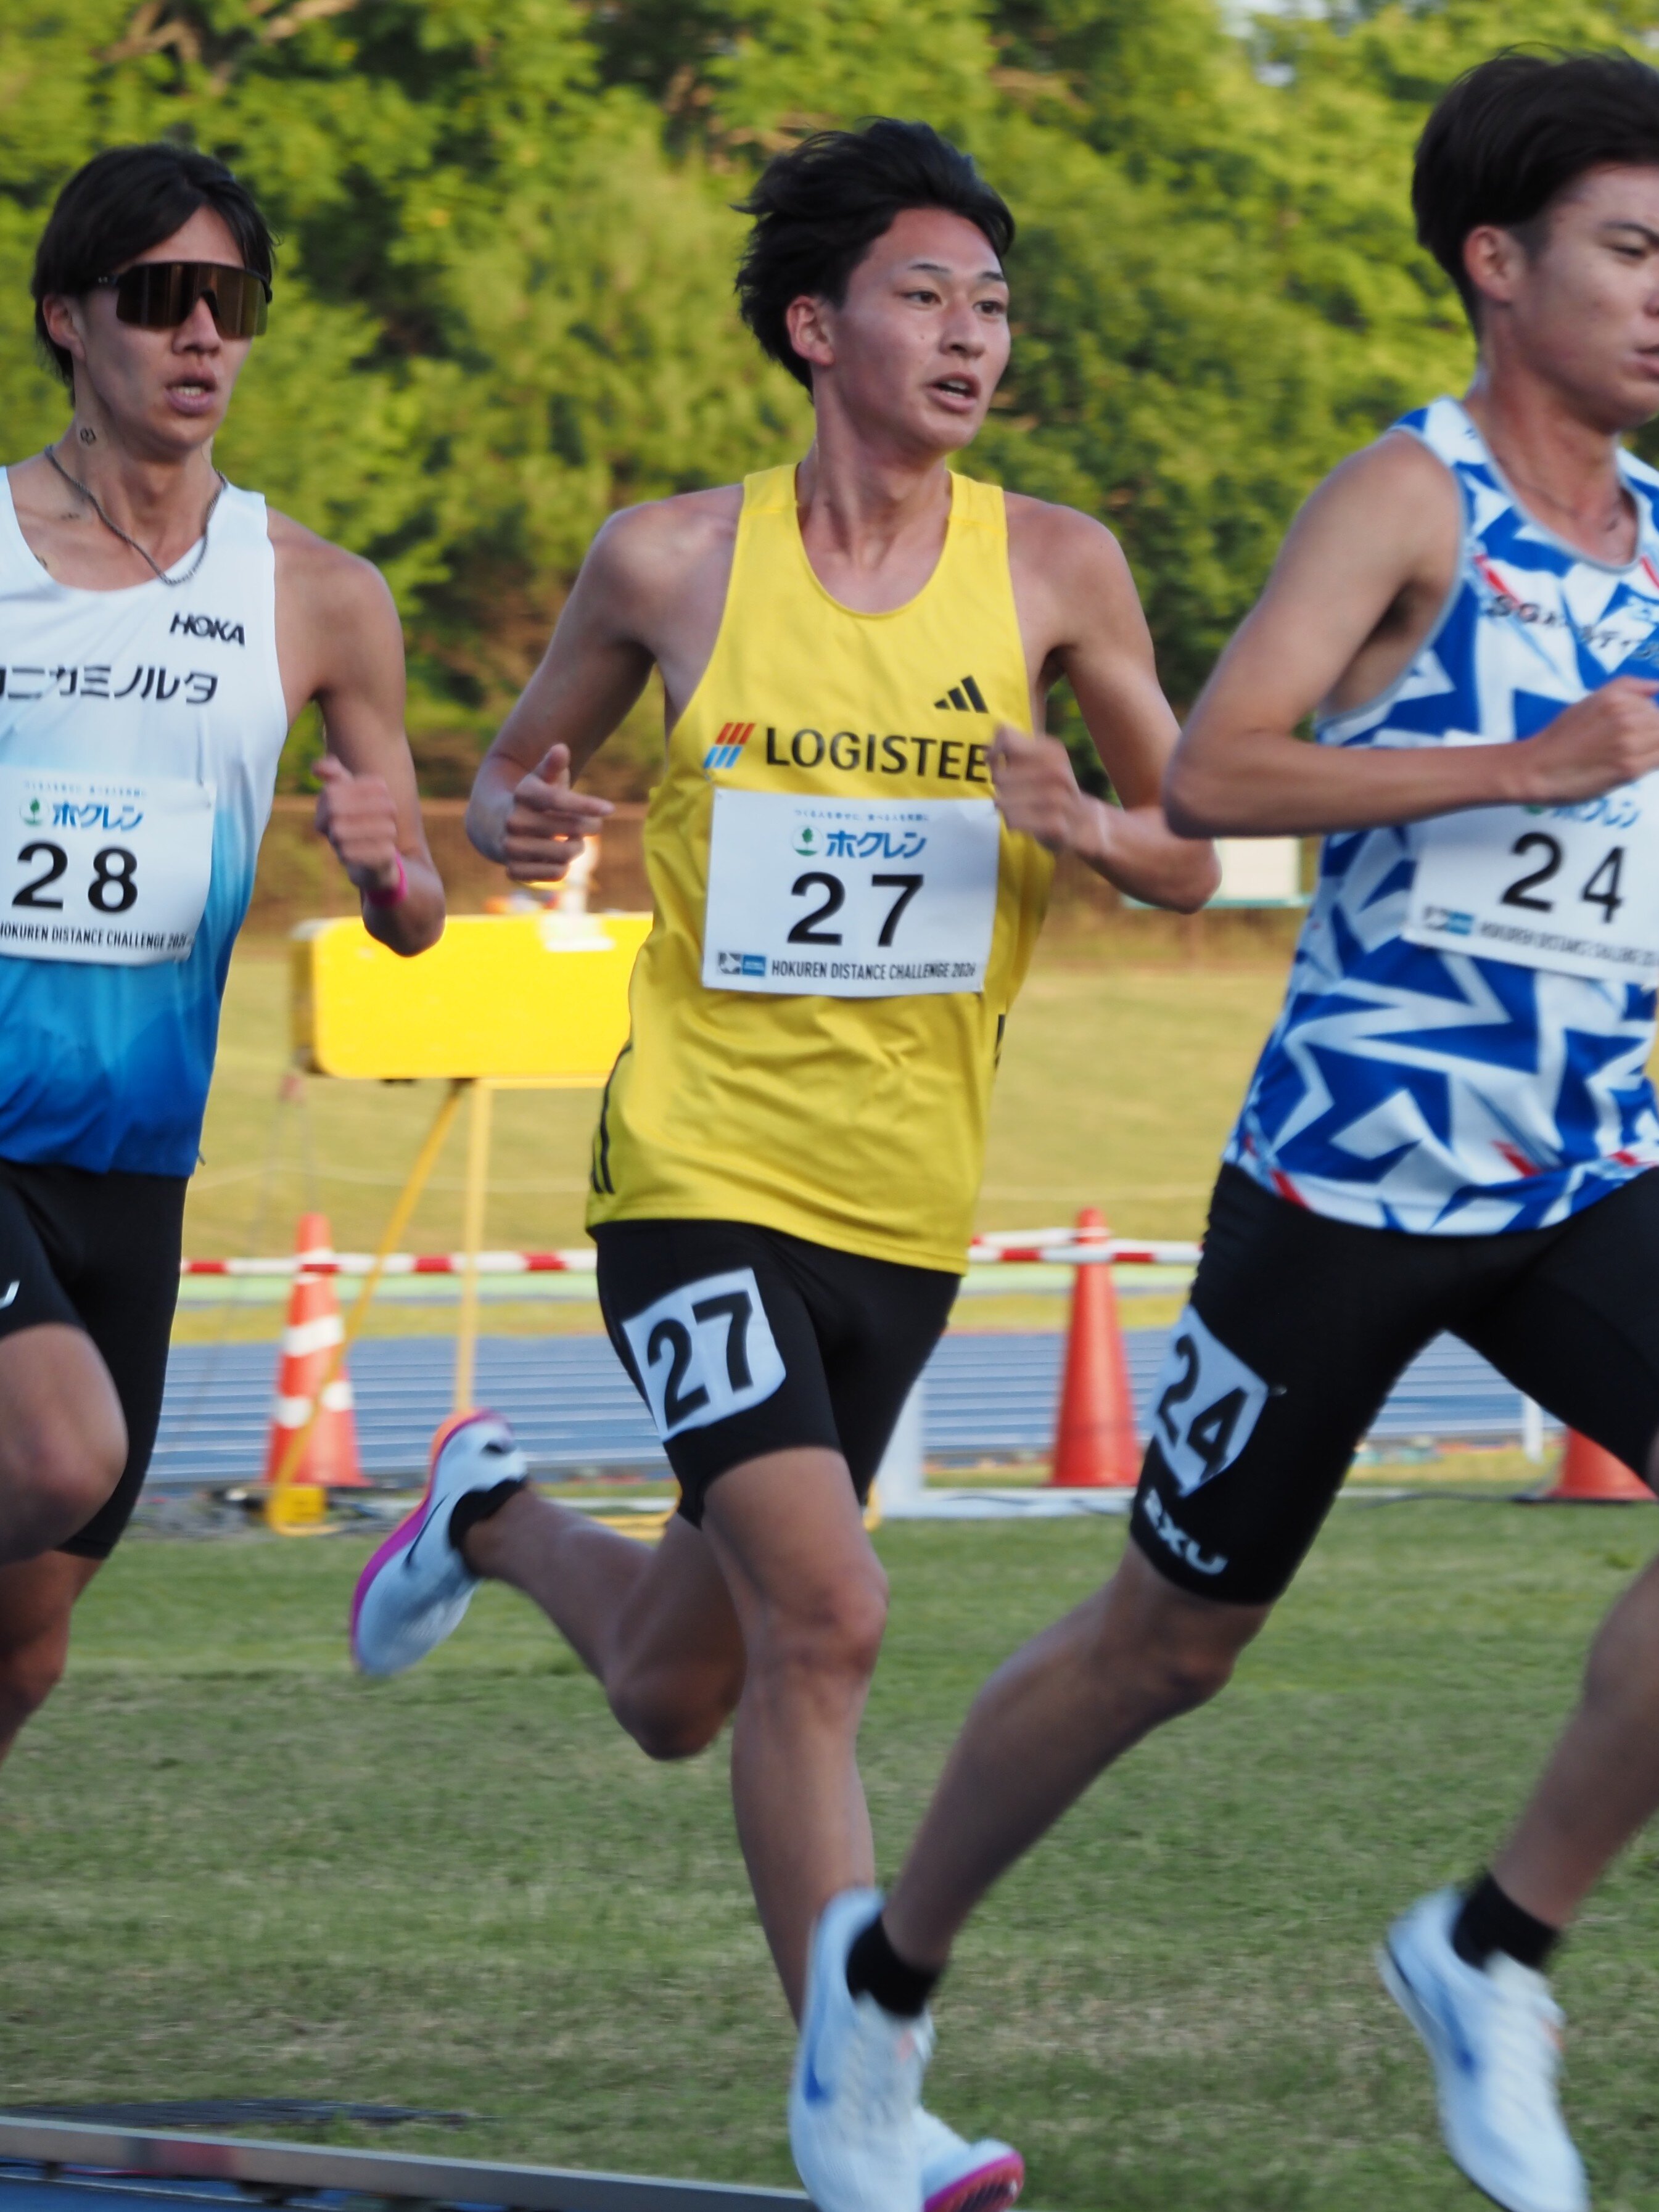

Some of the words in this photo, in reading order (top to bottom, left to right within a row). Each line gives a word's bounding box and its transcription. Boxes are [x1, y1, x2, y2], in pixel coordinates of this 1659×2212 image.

[170, 612, 245, 647] HOKA
[0, 664, 218, 705] ニカミノルタ
[52, 800, 144, 832] ホクレン
[826, 830, 928, 859] ホクレン
[11, 841, 138, 914] 28
[1501, 831, 1625, 924] 24
[786, 871, 924, 948] 27
[51, 927, 103, 947] DISTANCE
[106, 931, 164, 951] CHALLENGE
[771, 960, 827, 978] HOKUREN
[831, 963, 886, 981] DISTANCE
[889, 961, 950, 980] CHALLENGE
[647, 1289, 754, 1432] 27
[1157, 1333, 1249, 1481] 24
